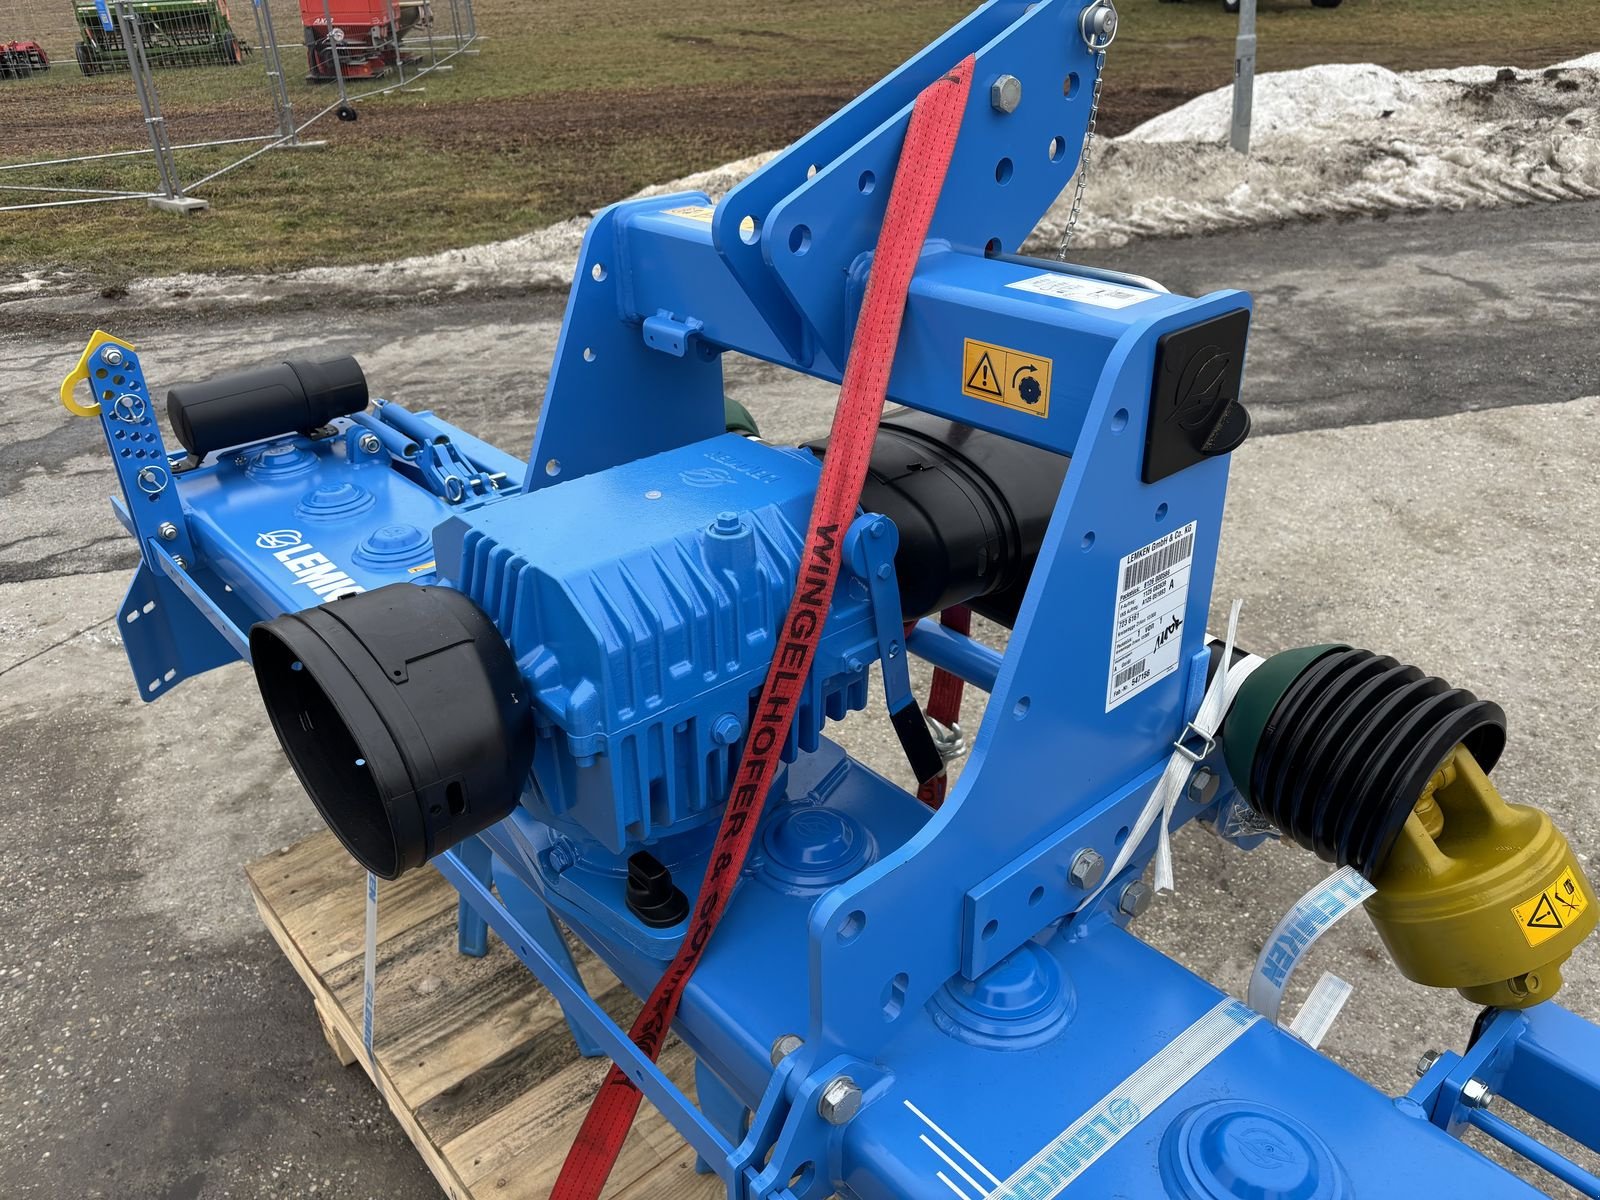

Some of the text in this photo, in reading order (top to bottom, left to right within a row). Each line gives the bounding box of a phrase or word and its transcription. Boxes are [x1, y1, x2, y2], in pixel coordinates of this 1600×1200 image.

[1127, 524, 1192, 564] LEMKEN GmbH & Co. KG
[272, 543, 367, 602] LEMK
[1169, 579, 1174, 590] A
[1145, 623, 1154, 632] von
[722, 524, 839, 841] WINGELHOFER
[713, 852, 732, 880] &
[1260, 879, 1361, 989] LEMKEN
